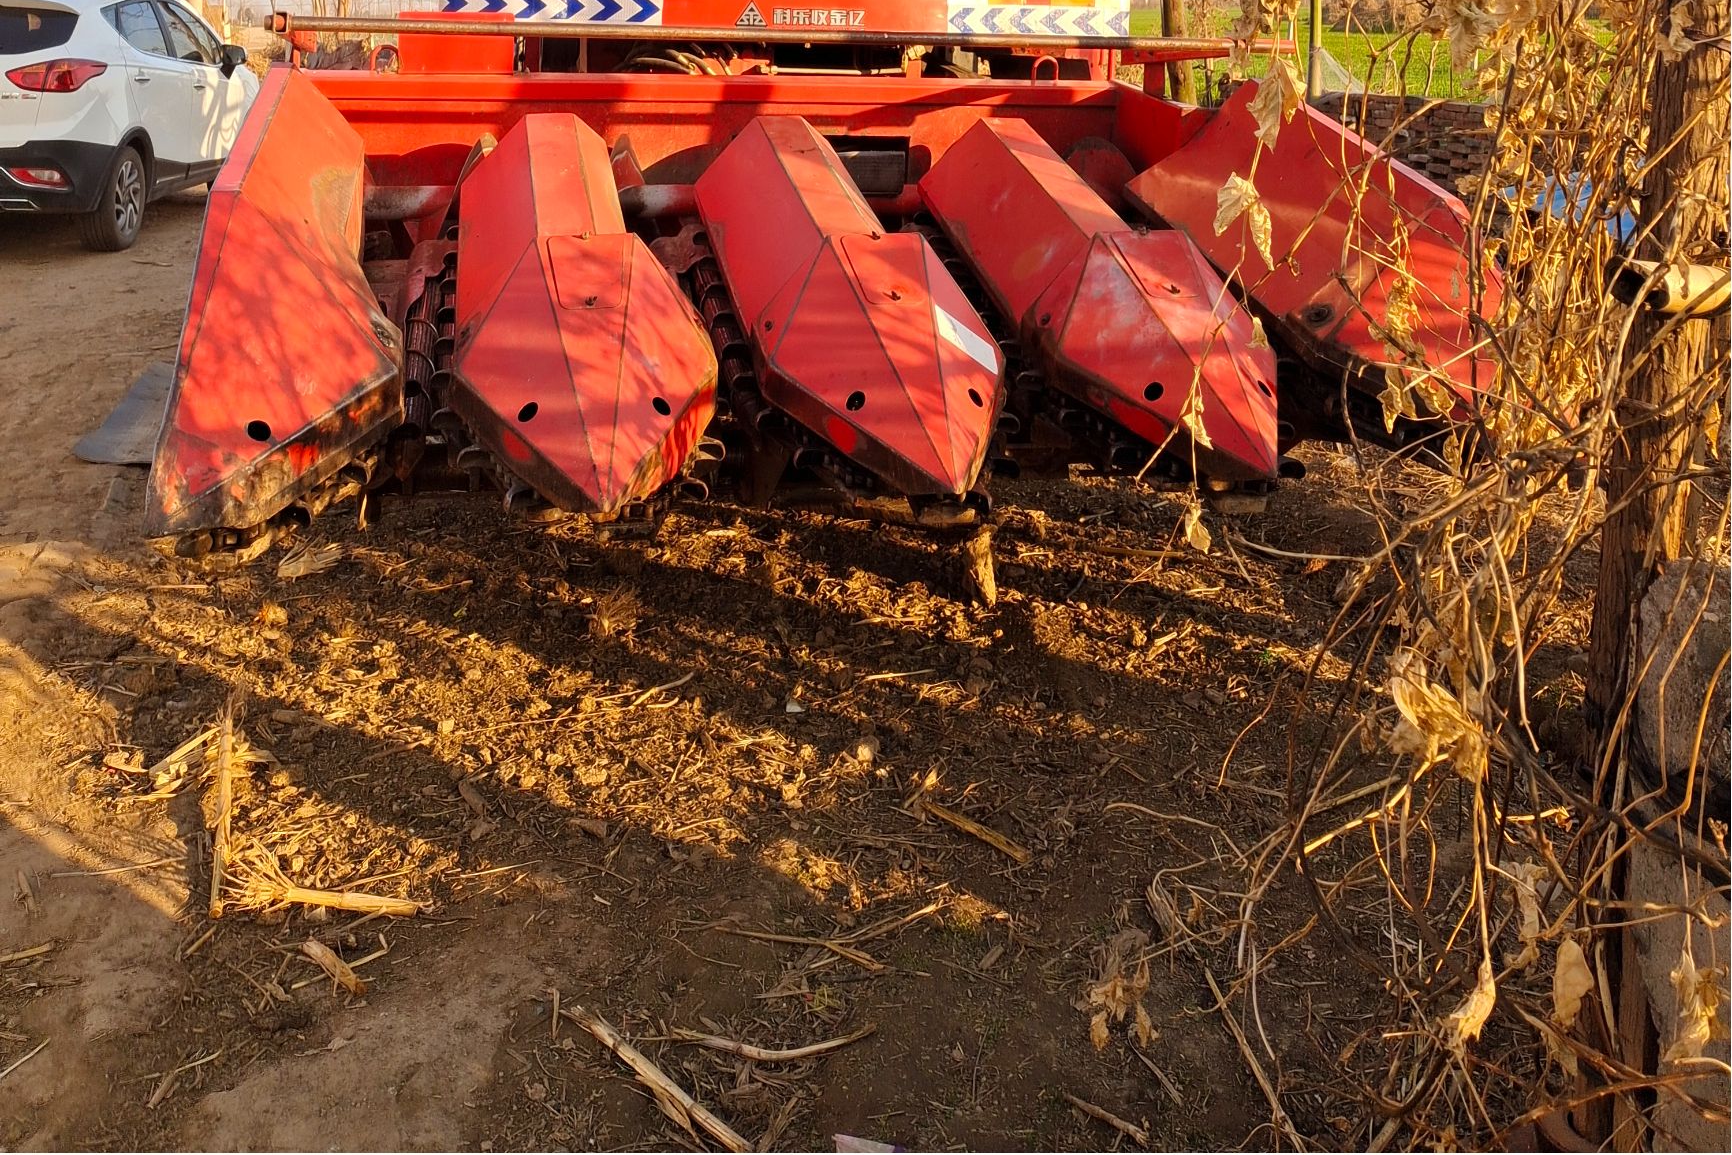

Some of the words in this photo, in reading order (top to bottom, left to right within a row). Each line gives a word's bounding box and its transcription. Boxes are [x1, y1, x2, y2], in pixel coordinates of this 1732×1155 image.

[773, 8, 865, 26] 科乐收金亿
